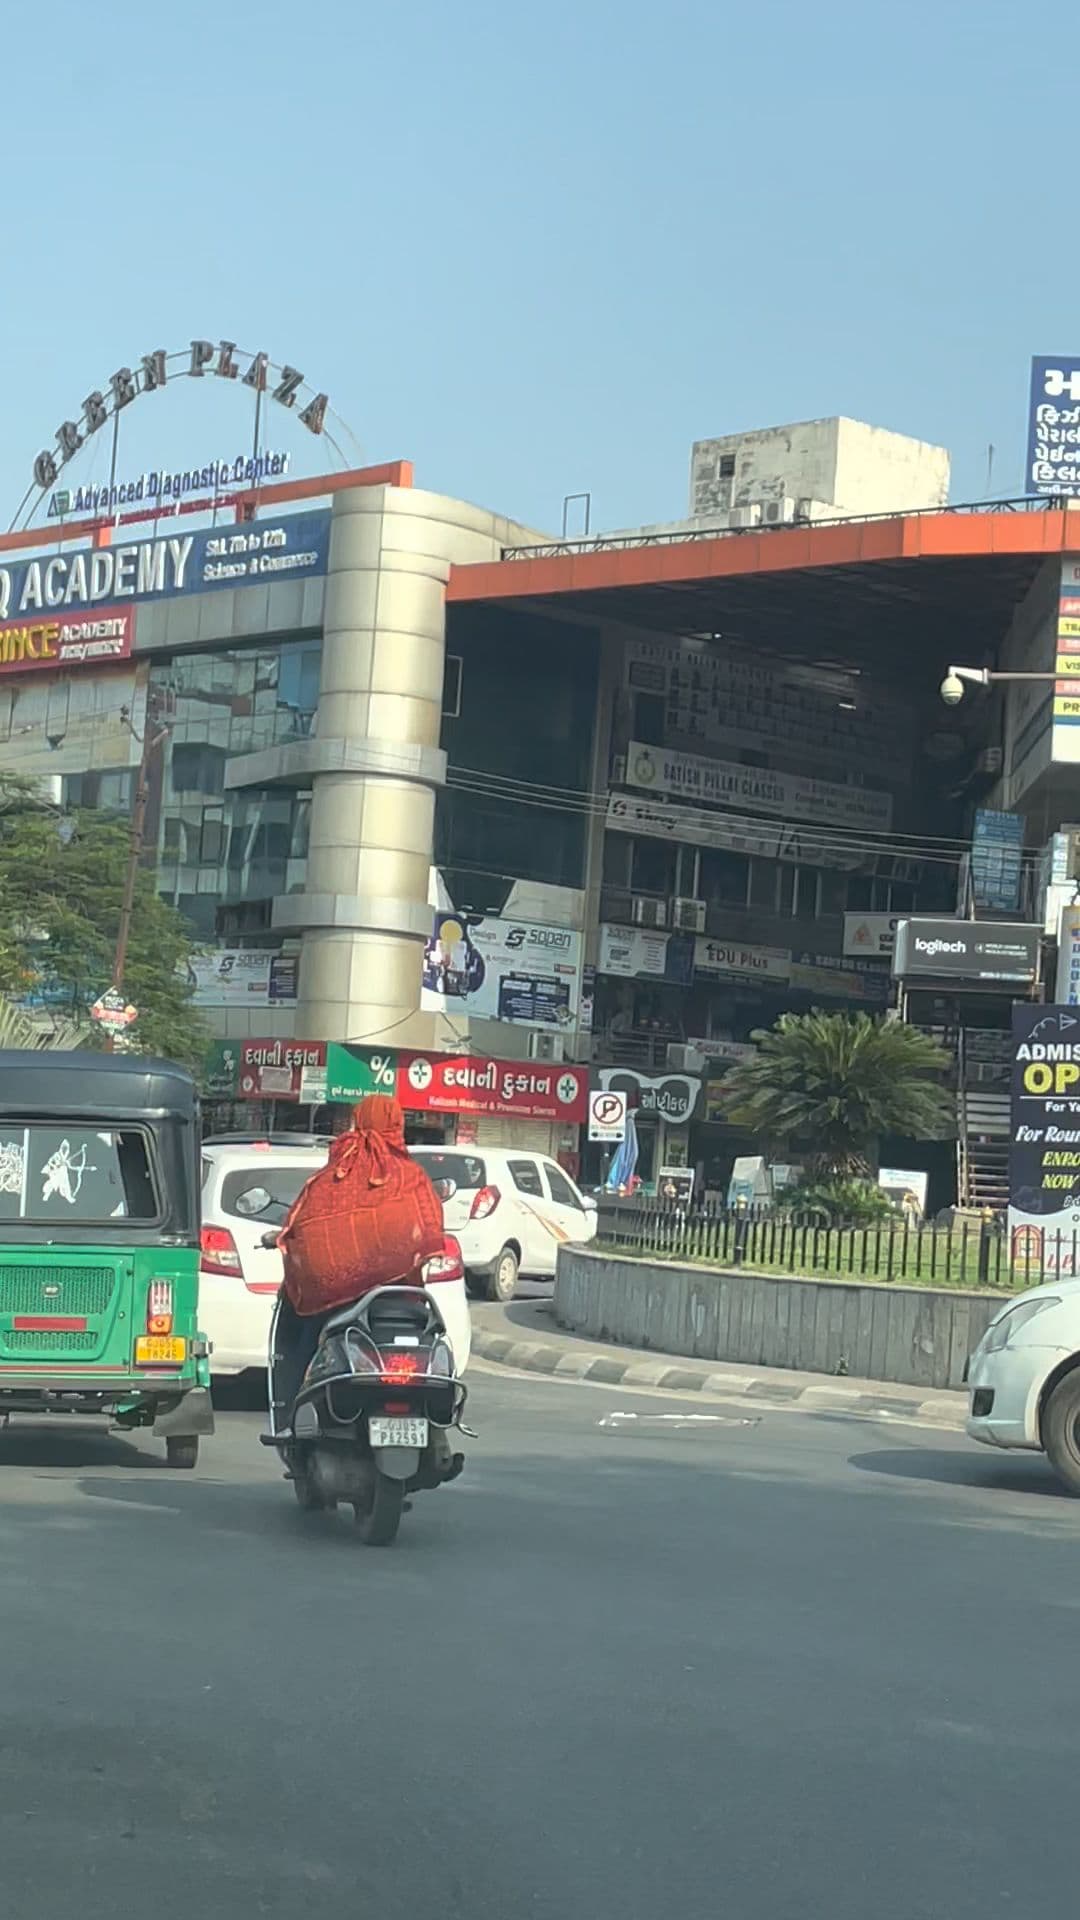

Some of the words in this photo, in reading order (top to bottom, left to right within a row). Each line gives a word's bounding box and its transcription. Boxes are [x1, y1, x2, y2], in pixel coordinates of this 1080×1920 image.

[35, 350, 166, 488] GREEN
[189, 340, 329, 435] PLAZA
[74, 473, 145, 512] Advanced
[148, 461, 229, 498] Diagnostic
[234, 451, 290, 482] Center
[19, 535, 194, 611] ACADEMY
[0, 622, 60, 663] INCE
[708, 949, 735, 964] EDU
[915, 938, 967, 955] logitech
[245, 1040, 282, 1066] દવાની
[443, 1062, 497, 1090] દવાની
[502, 1073, 551, 1099] દુકાન
[1024, 1062, 1080, 1094] OP
[1045, 1101, 1066, 1112] For
[1015, 1125, 1044, 1142] For
[1042, 1174, 1080, 1189] NOW
